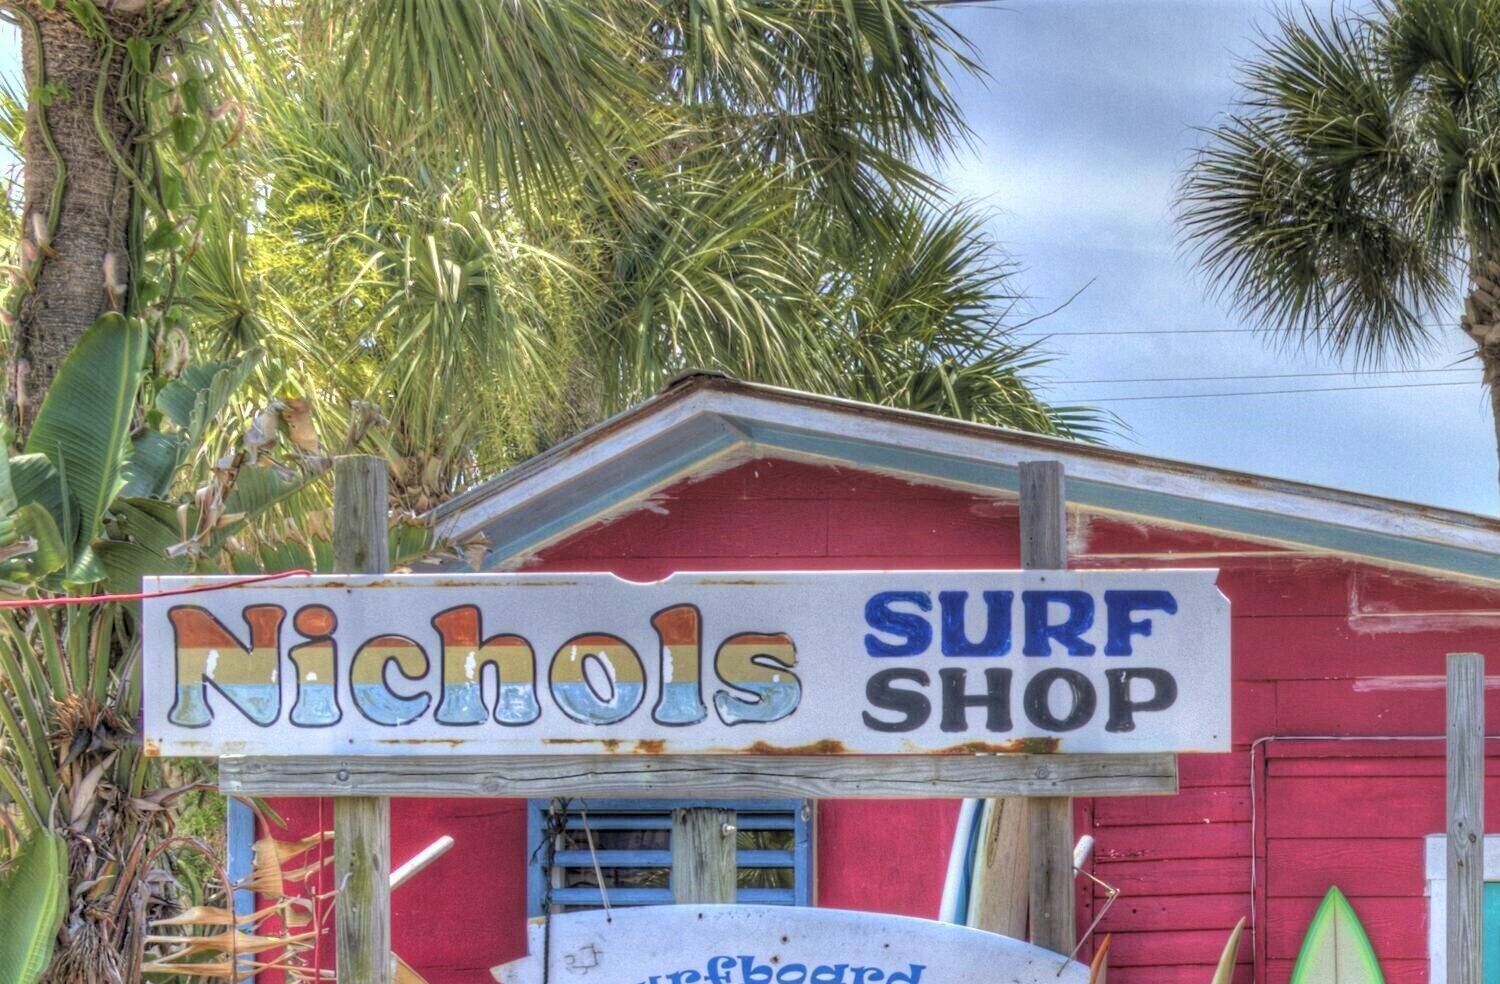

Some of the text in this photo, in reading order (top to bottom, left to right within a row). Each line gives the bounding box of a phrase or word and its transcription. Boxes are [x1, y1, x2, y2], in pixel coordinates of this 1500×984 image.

[864, 590, 1178, 657] SURF
[167, 602, 801, 728] Nichols
[862, 667, 1178, 733] SHOP
